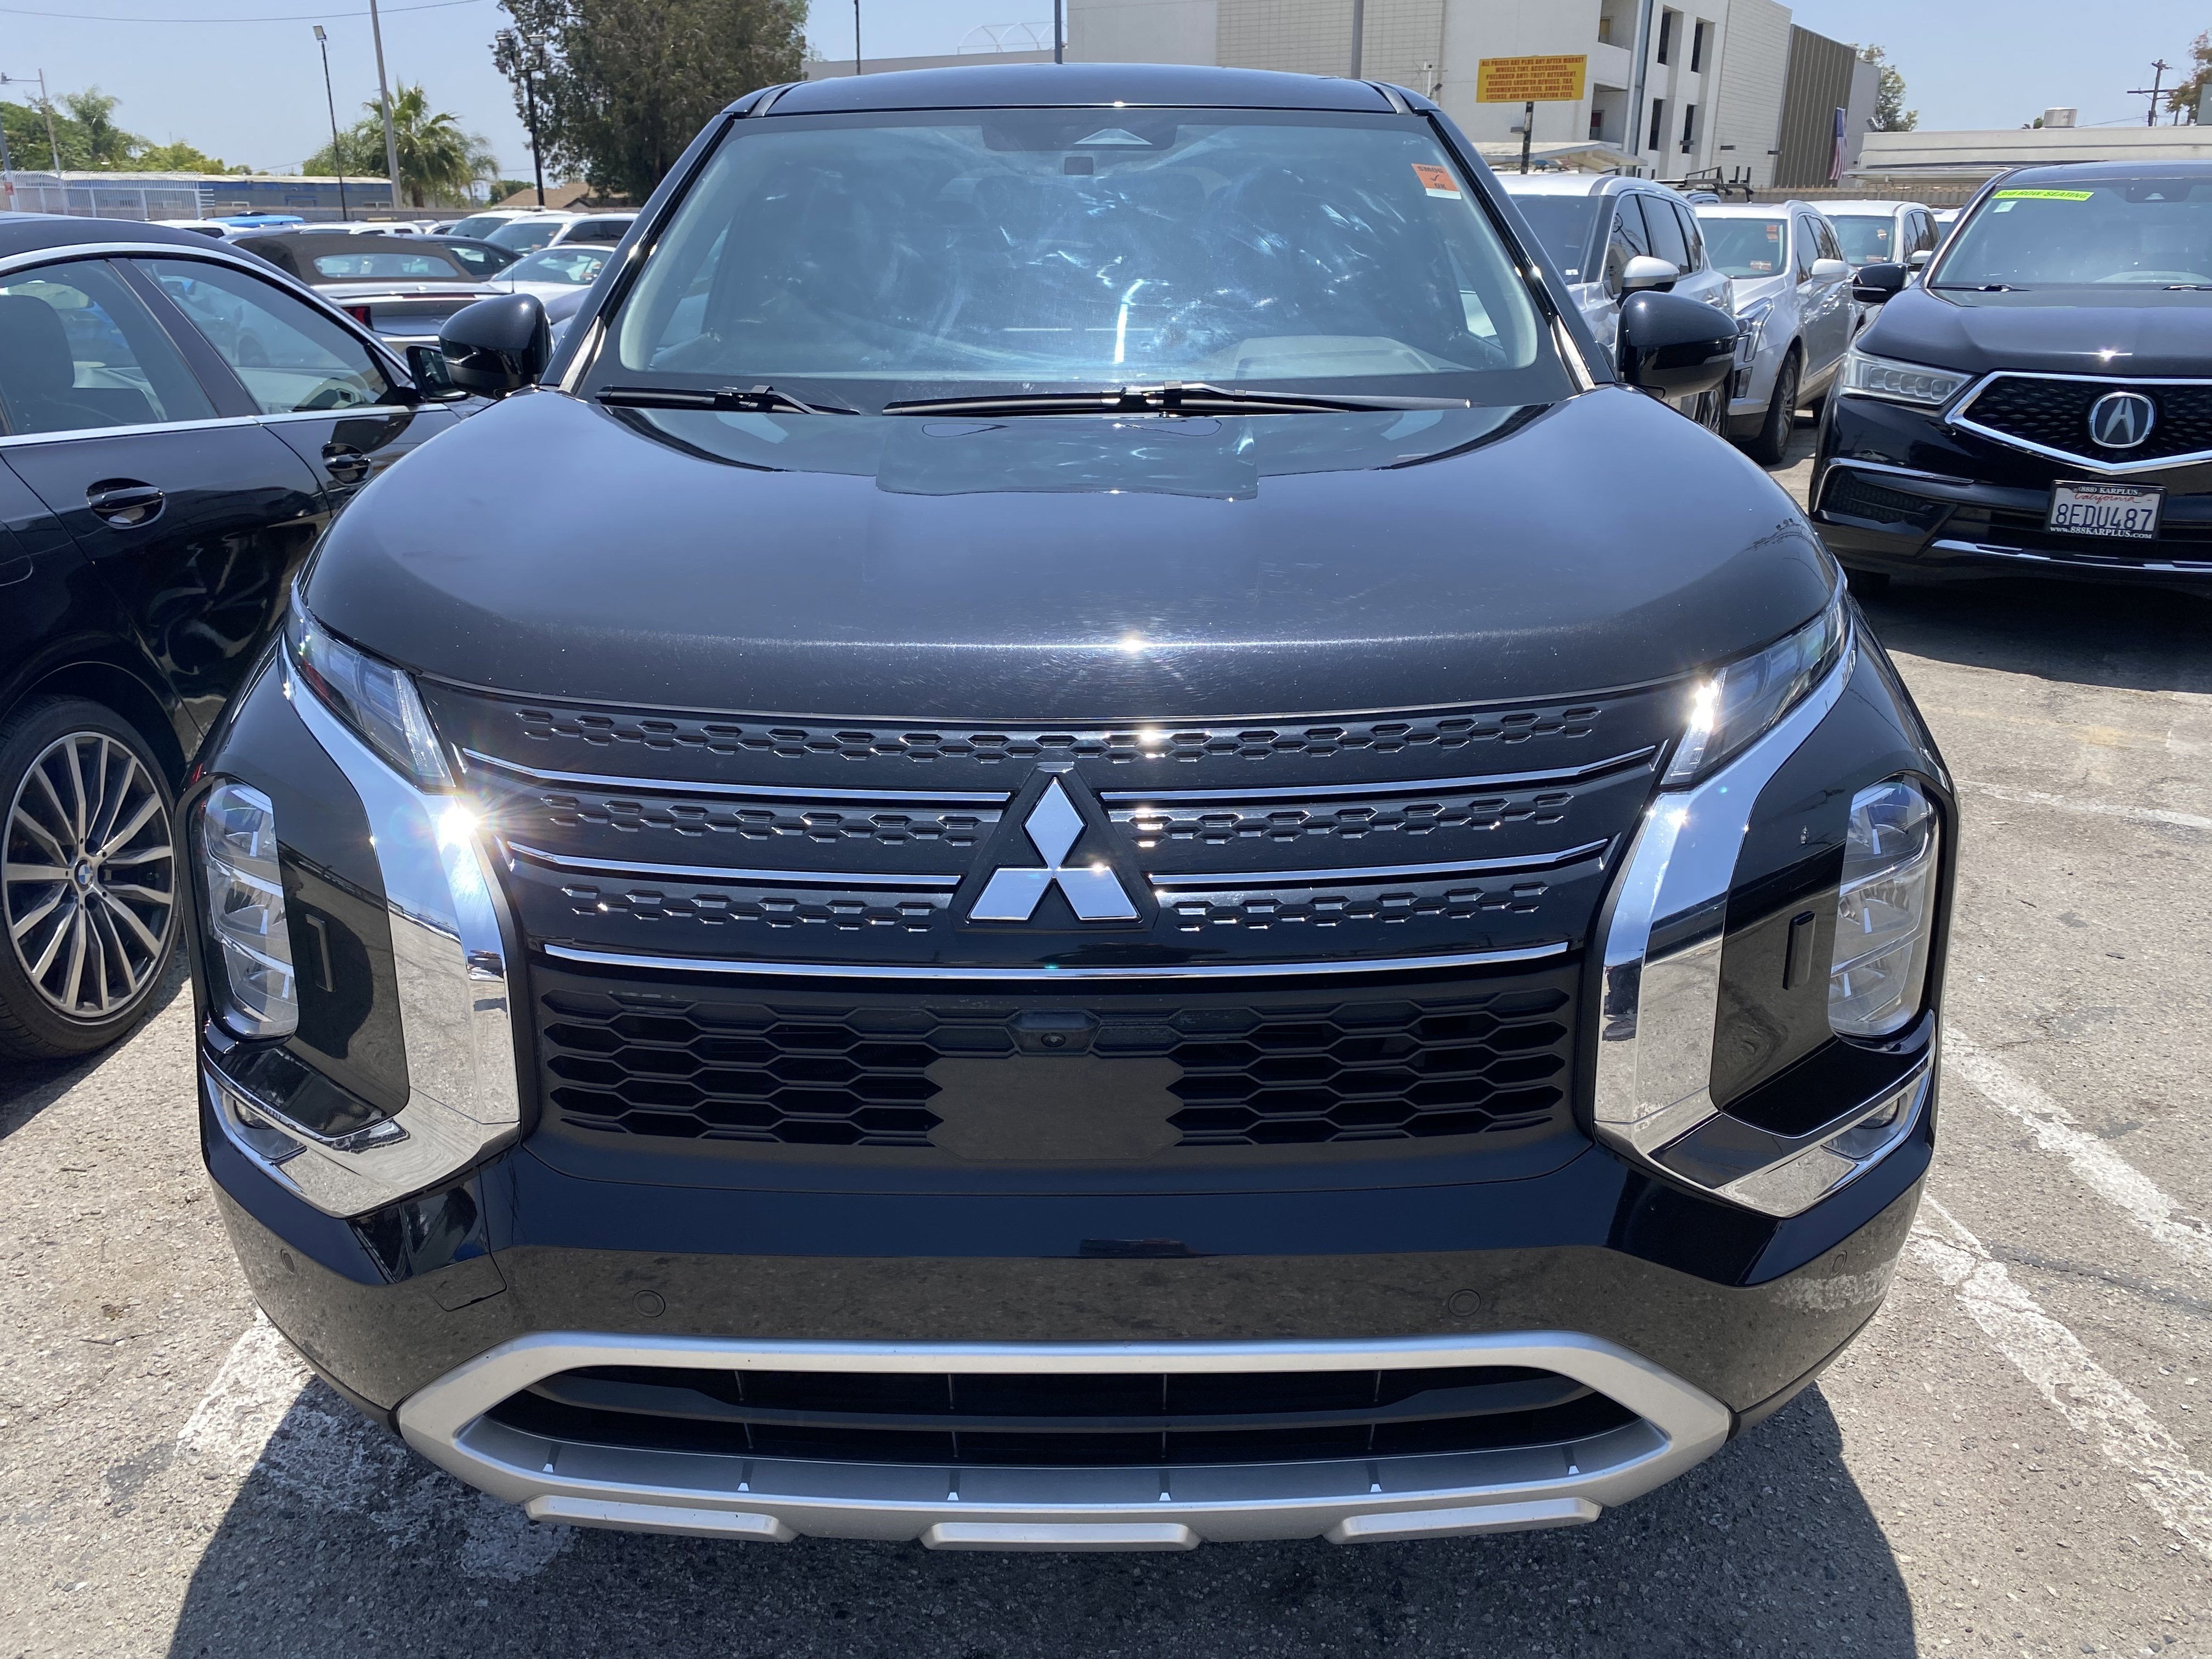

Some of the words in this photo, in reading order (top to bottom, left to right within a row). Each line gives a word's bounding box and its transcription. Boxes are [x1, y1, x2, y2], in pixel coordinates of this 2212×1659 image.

[2099, 487, 2138, 495] KARPLUS
[2074, 493, 2142, 504] California
[2056, 503, 2153, 531] 8EDU487
